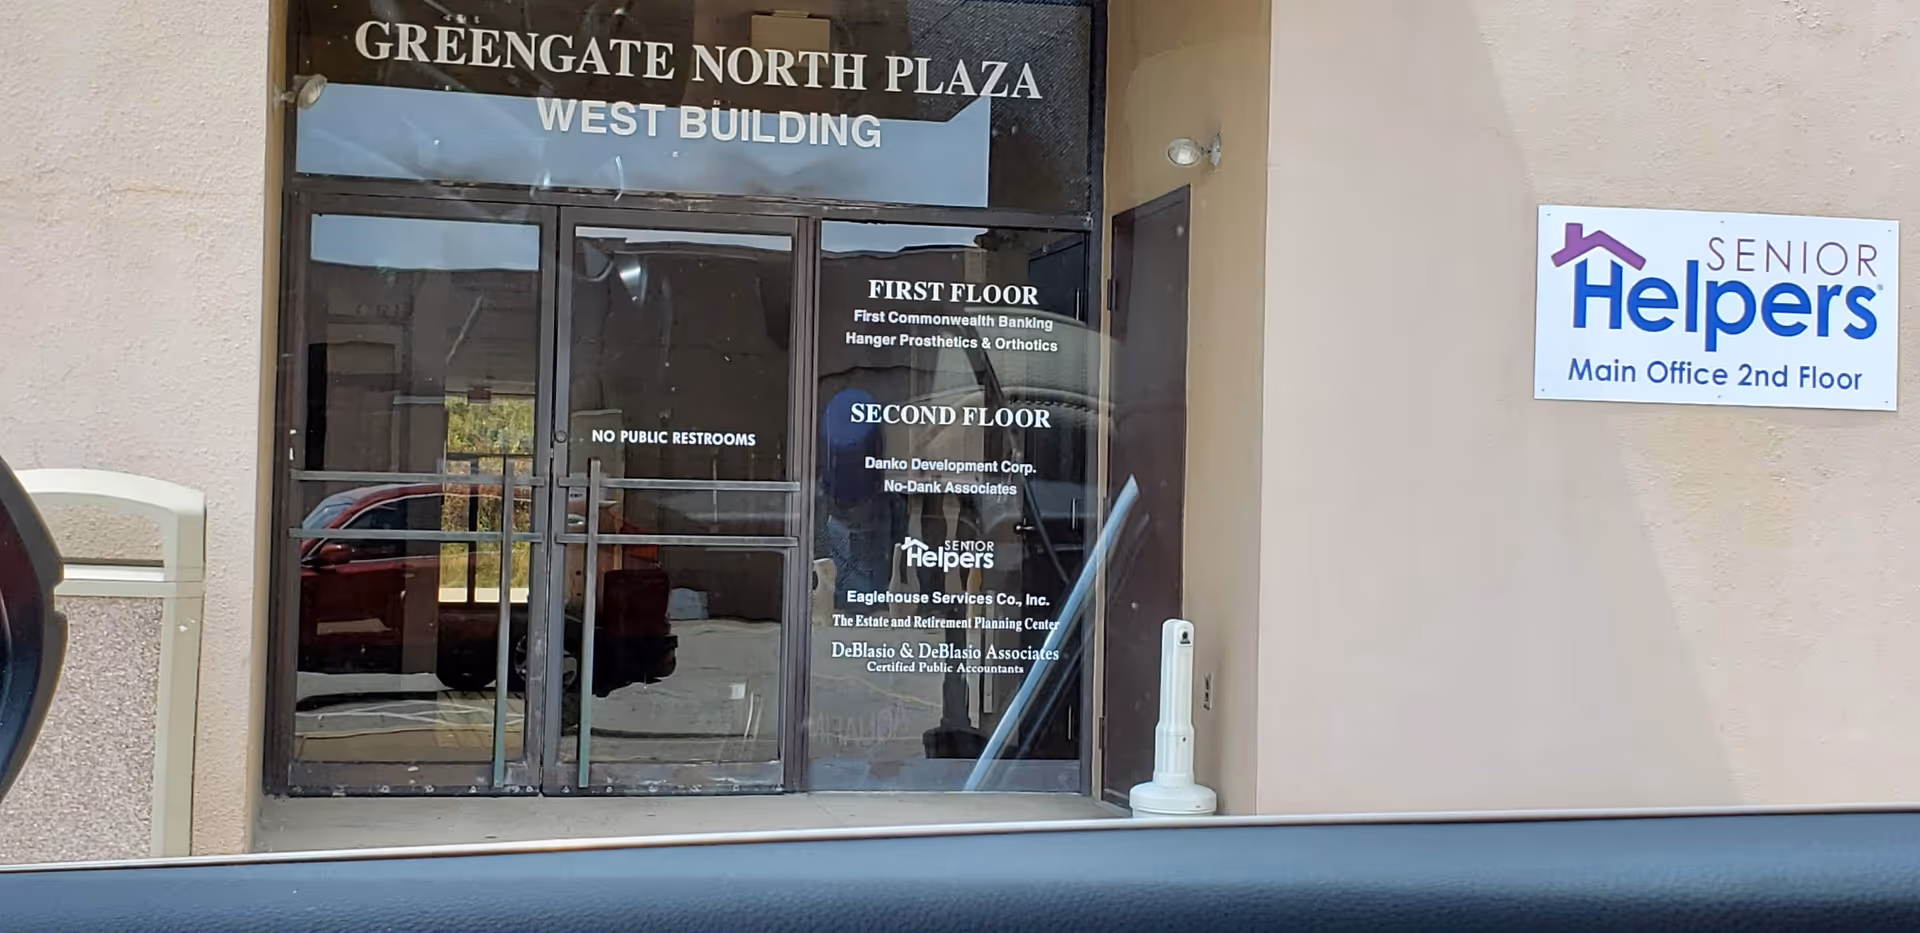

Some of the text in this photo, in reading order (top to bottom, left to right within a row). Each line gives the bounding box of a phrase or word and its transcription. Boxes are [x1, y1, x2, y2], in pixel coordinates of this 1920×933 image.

[355, 20, 1043, 99] GREENGATE NORTH PLAZA
[536, 97, 881, 148] WEST BUILDING
[1706, 236, 1878, 278] SENIOR
[868, 279, 1040, 306] FIRST FLOOR
[1572, 257, 1878, 352] Helpers
[853, 309, 1053, 332] First Commonwealth Banking
[846, 332, 1058, 352] Hanger Prosthetics & Orthotics
[1568, 358, 1863, 390] Main Office 2nd Floor
[851, 403, 1051, 429] SECOND FLOOR
[592, 429, 756, 446] NO PUBLIC RESTROOMS
[865, 456, 1037, 476] Danko Development Corp.
[884, 479, 1017, 495] No-Dank Associates
[944, 540, 994, 552] SENIOR
[907, 546, 994, 572] Helpers
[847, 590, 1050, 607] Eaglehouse Services Co., Inc.
[832, 614, 1060, 632] The Estate and Retirement Planning Center
[832, 642, 1059, 660] DeBlasio & DeBlasio Associates
[867, 661, 1024, 674] Certified Public Accountants
